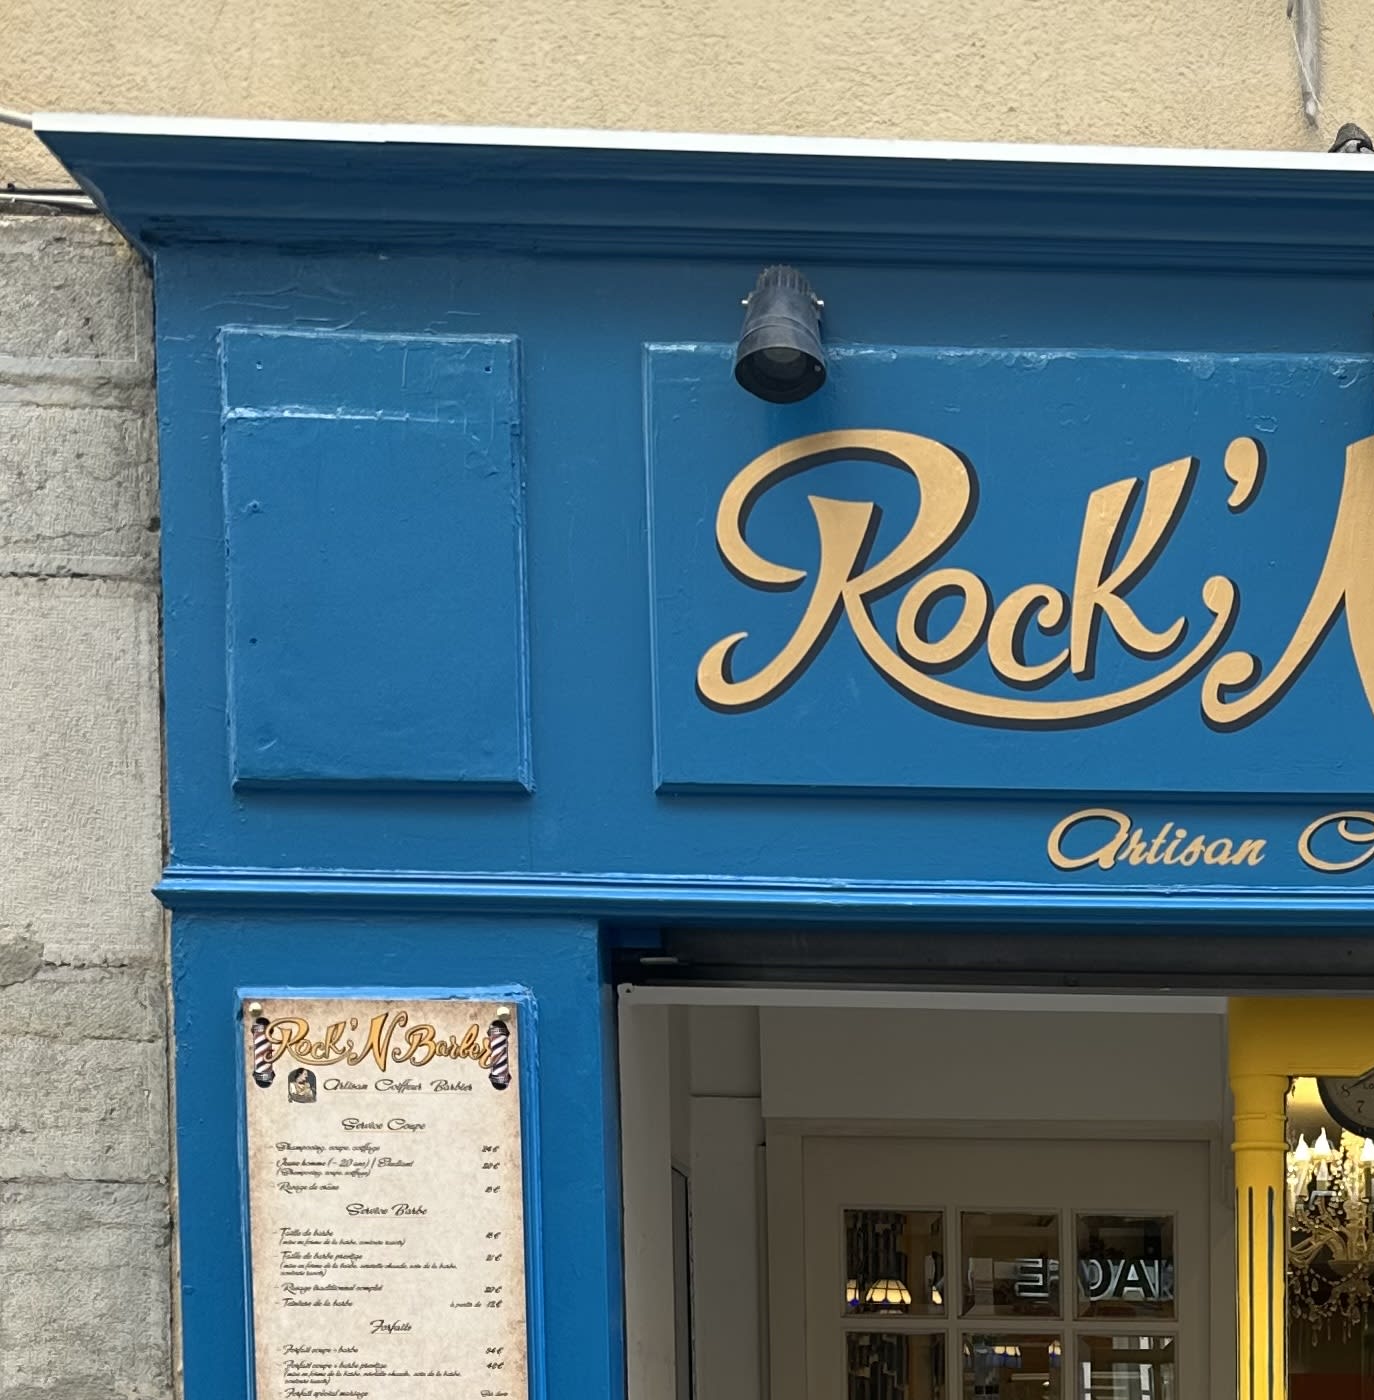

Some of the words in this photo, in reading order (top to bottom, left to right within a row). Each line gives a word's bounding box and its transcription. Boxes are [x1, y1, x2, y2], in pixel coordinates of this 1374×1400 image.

[1047, 808, 1265, 870] Artisan
[323, 1078, 369, 1092] Artisan
[374, 1079, 423, 1094] Coiffeur
[430, 1079, 473, 1092] Barbier
[341, 1117, 384, 1131] Service
[387, 1118, 426, 1132] Coupe
[346, 1203, 389, 1216] Service
[391, 1203, 428, 1217] Barbe
